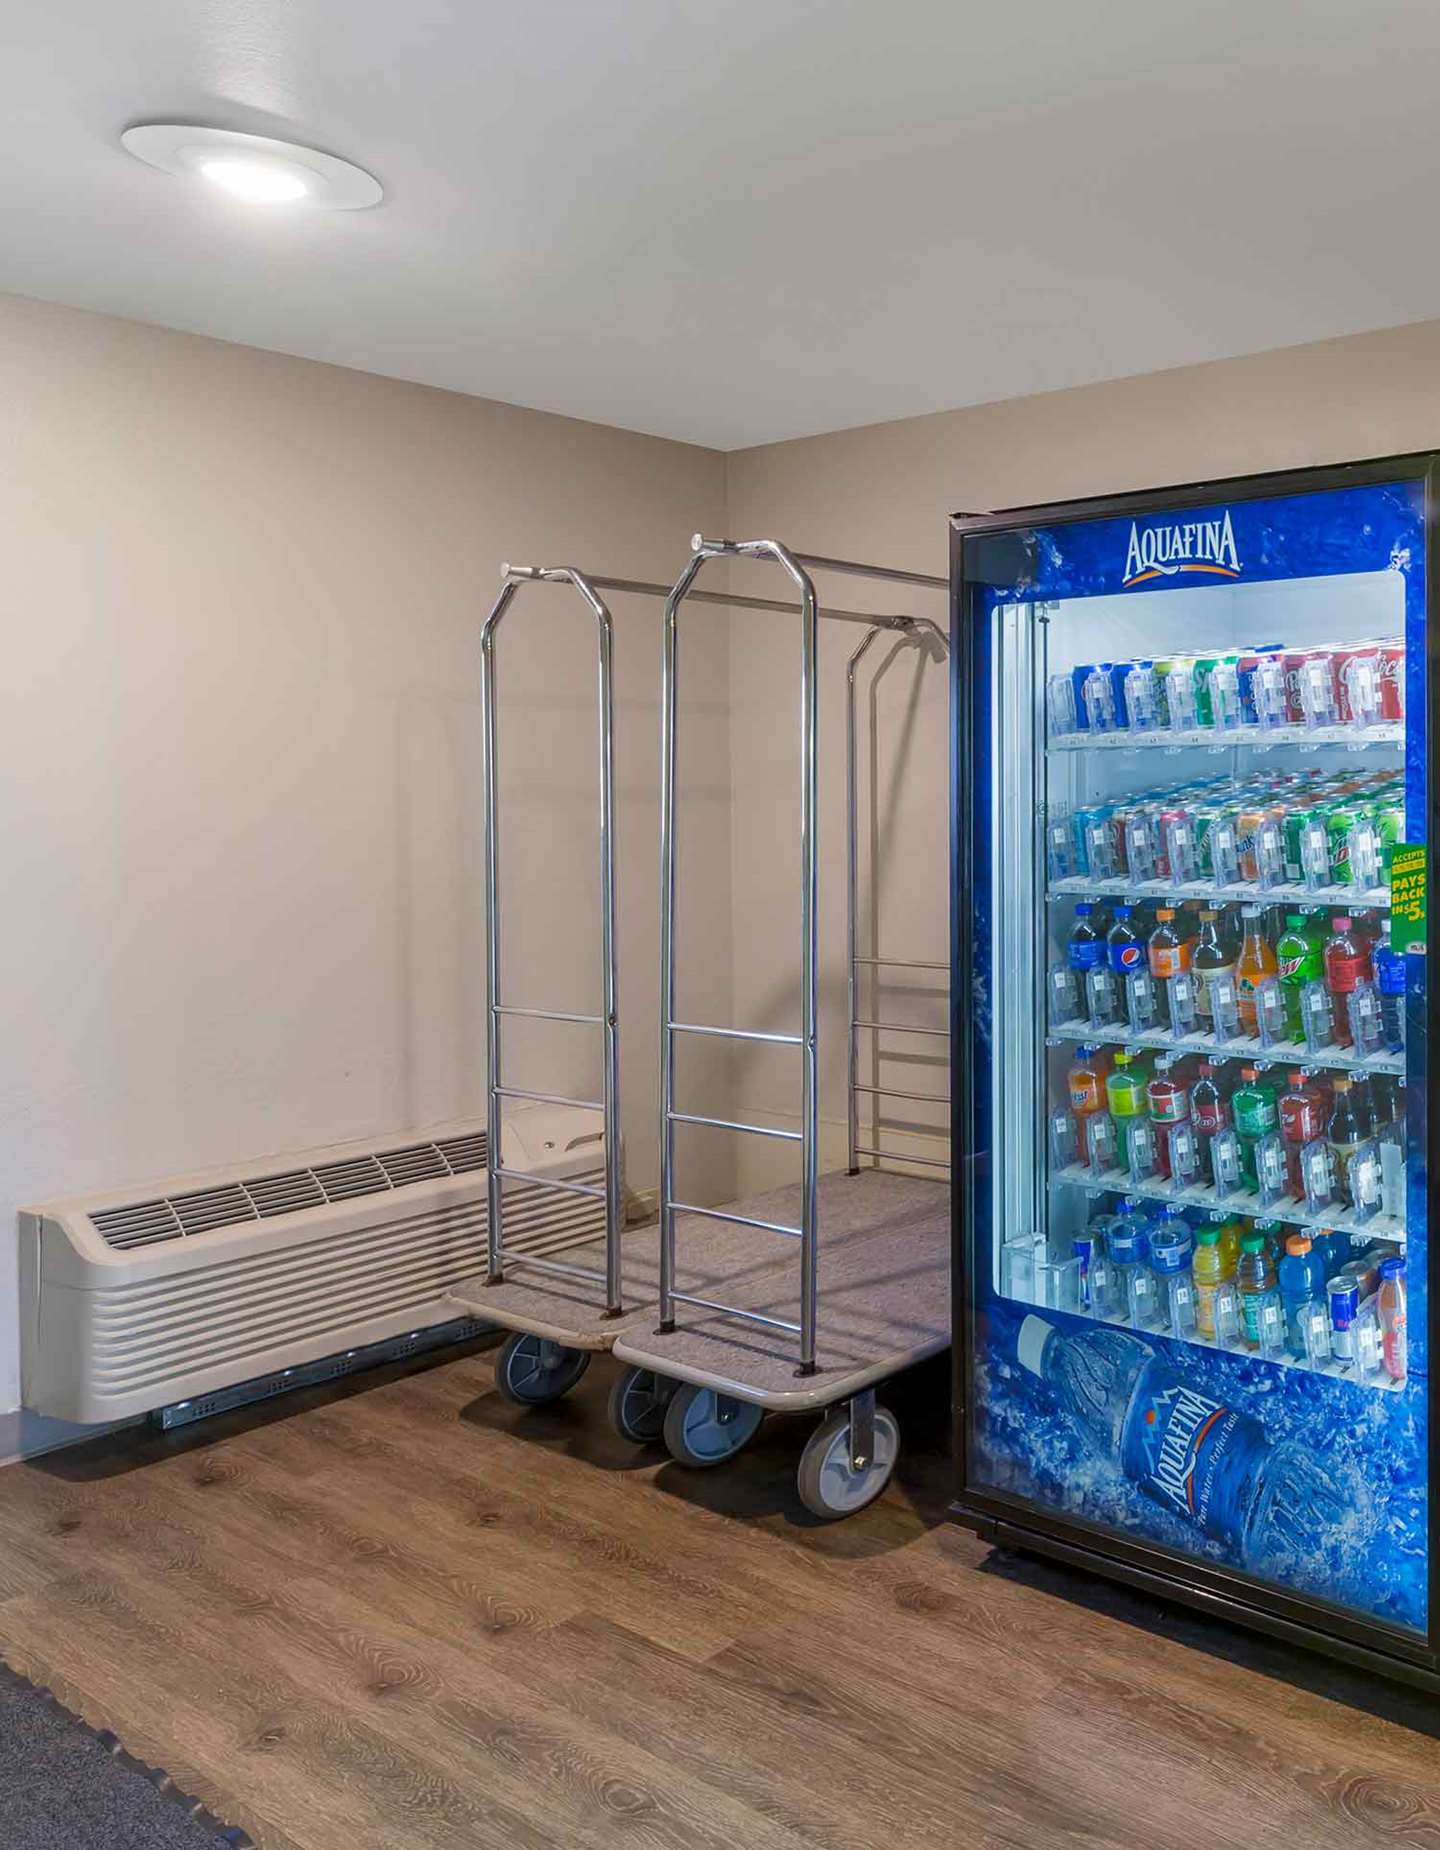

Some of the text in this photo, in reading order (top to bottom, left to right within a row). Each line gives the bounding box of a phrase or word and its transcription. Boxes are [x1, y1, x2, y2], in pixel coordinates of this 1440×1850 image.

[1122, 510, 1241, 583] AQUAFINA
[1392, 873, 1425, 891] PAYS
[1392, 886, 1425, 904] BACK
[1150, 1385, 1223, 1514] AQUAFINA
